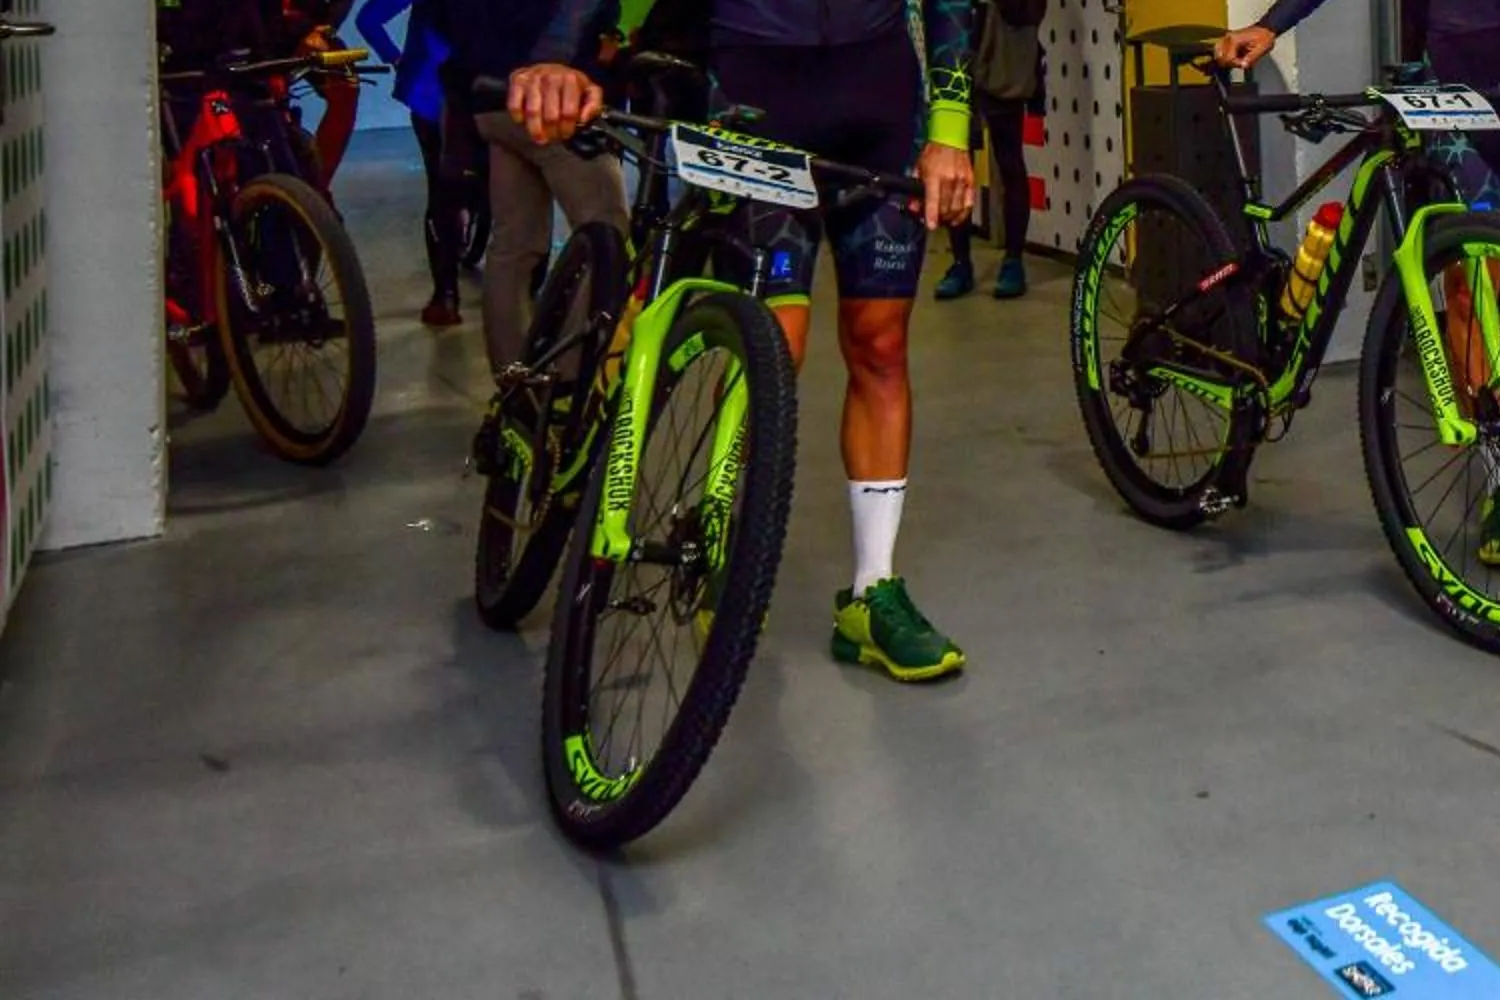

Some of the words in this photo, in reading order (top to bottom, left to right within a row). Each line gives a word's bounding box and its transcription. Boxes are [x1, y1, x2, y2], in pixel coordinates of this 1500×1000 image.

[1402, 93, 1473, 109] 67-1
[697, 149, 795, 185] 67-2
[1324, 902, 1417, 976] Dorsales
[1363, 890, 1470, 974] Recogida
